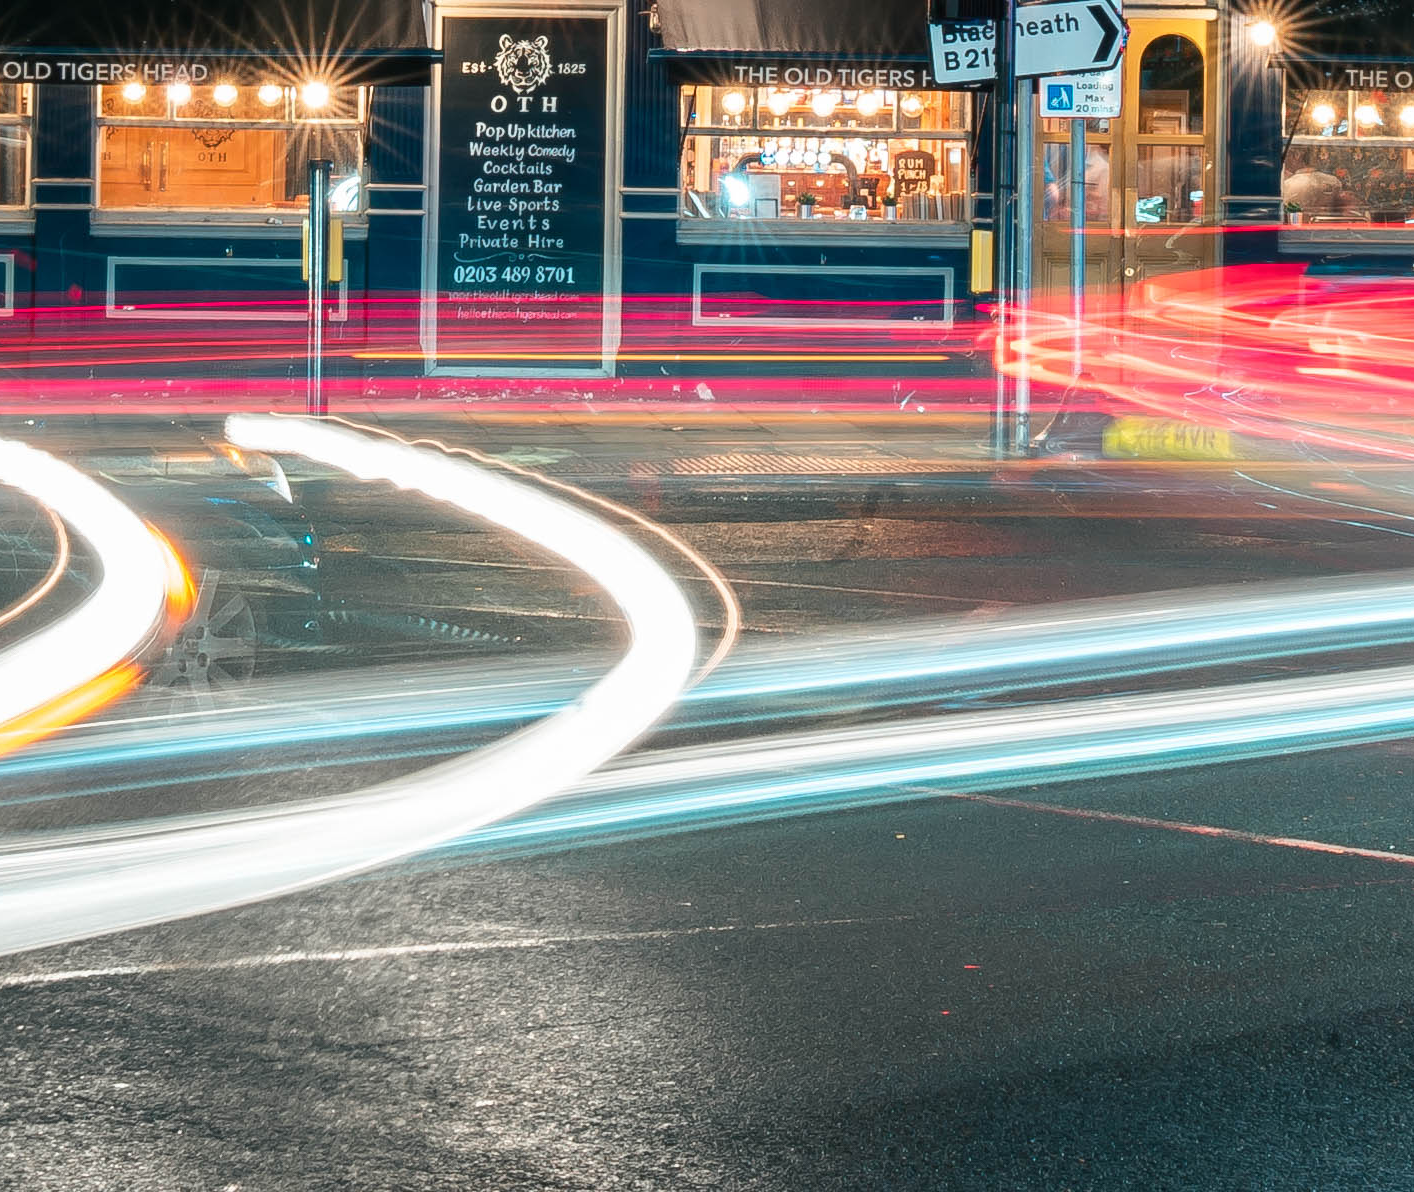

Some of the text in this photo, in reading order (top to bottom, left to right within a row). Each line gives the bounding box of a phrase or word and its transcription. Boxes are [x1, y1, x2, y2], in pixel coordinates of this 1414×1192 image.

[945, 47, 995, 71] B 21
[3, 61, 52, 80] OLD
[57, 62, 136, 81] TIGERS
[143, 63, 208, 82] HEAD
[557, 63, 586, 74] 1825
[735, 65, 779, 85] THE
[784, 67, 832, 87] OLD
[837, 68, 915, 88] TIGERS
[1076, 82, 1114, 91] Loading
[1345, 69, 1388, 88] THE
[1085, 94, 1105, 103] Max
[1076, 104, 1090, 113] 20
[475, 121, 577, 141] Pop Up kitchen
[469, 142, 576, 163] Weekly Comedy
[483, 161, 553, 176] Cocktails
[898, 158, 924, 169] RUM
[897, 168, 926, 180] PUNCH
[473, 178, 563, 194] Garden Bar
[467, 195, 560, 216] Live Sports
[477, 215, 550, 230] Events
[459, 233, 564, 249] Private Hire
[453, 265, 576, 284] 0203 489 8701
